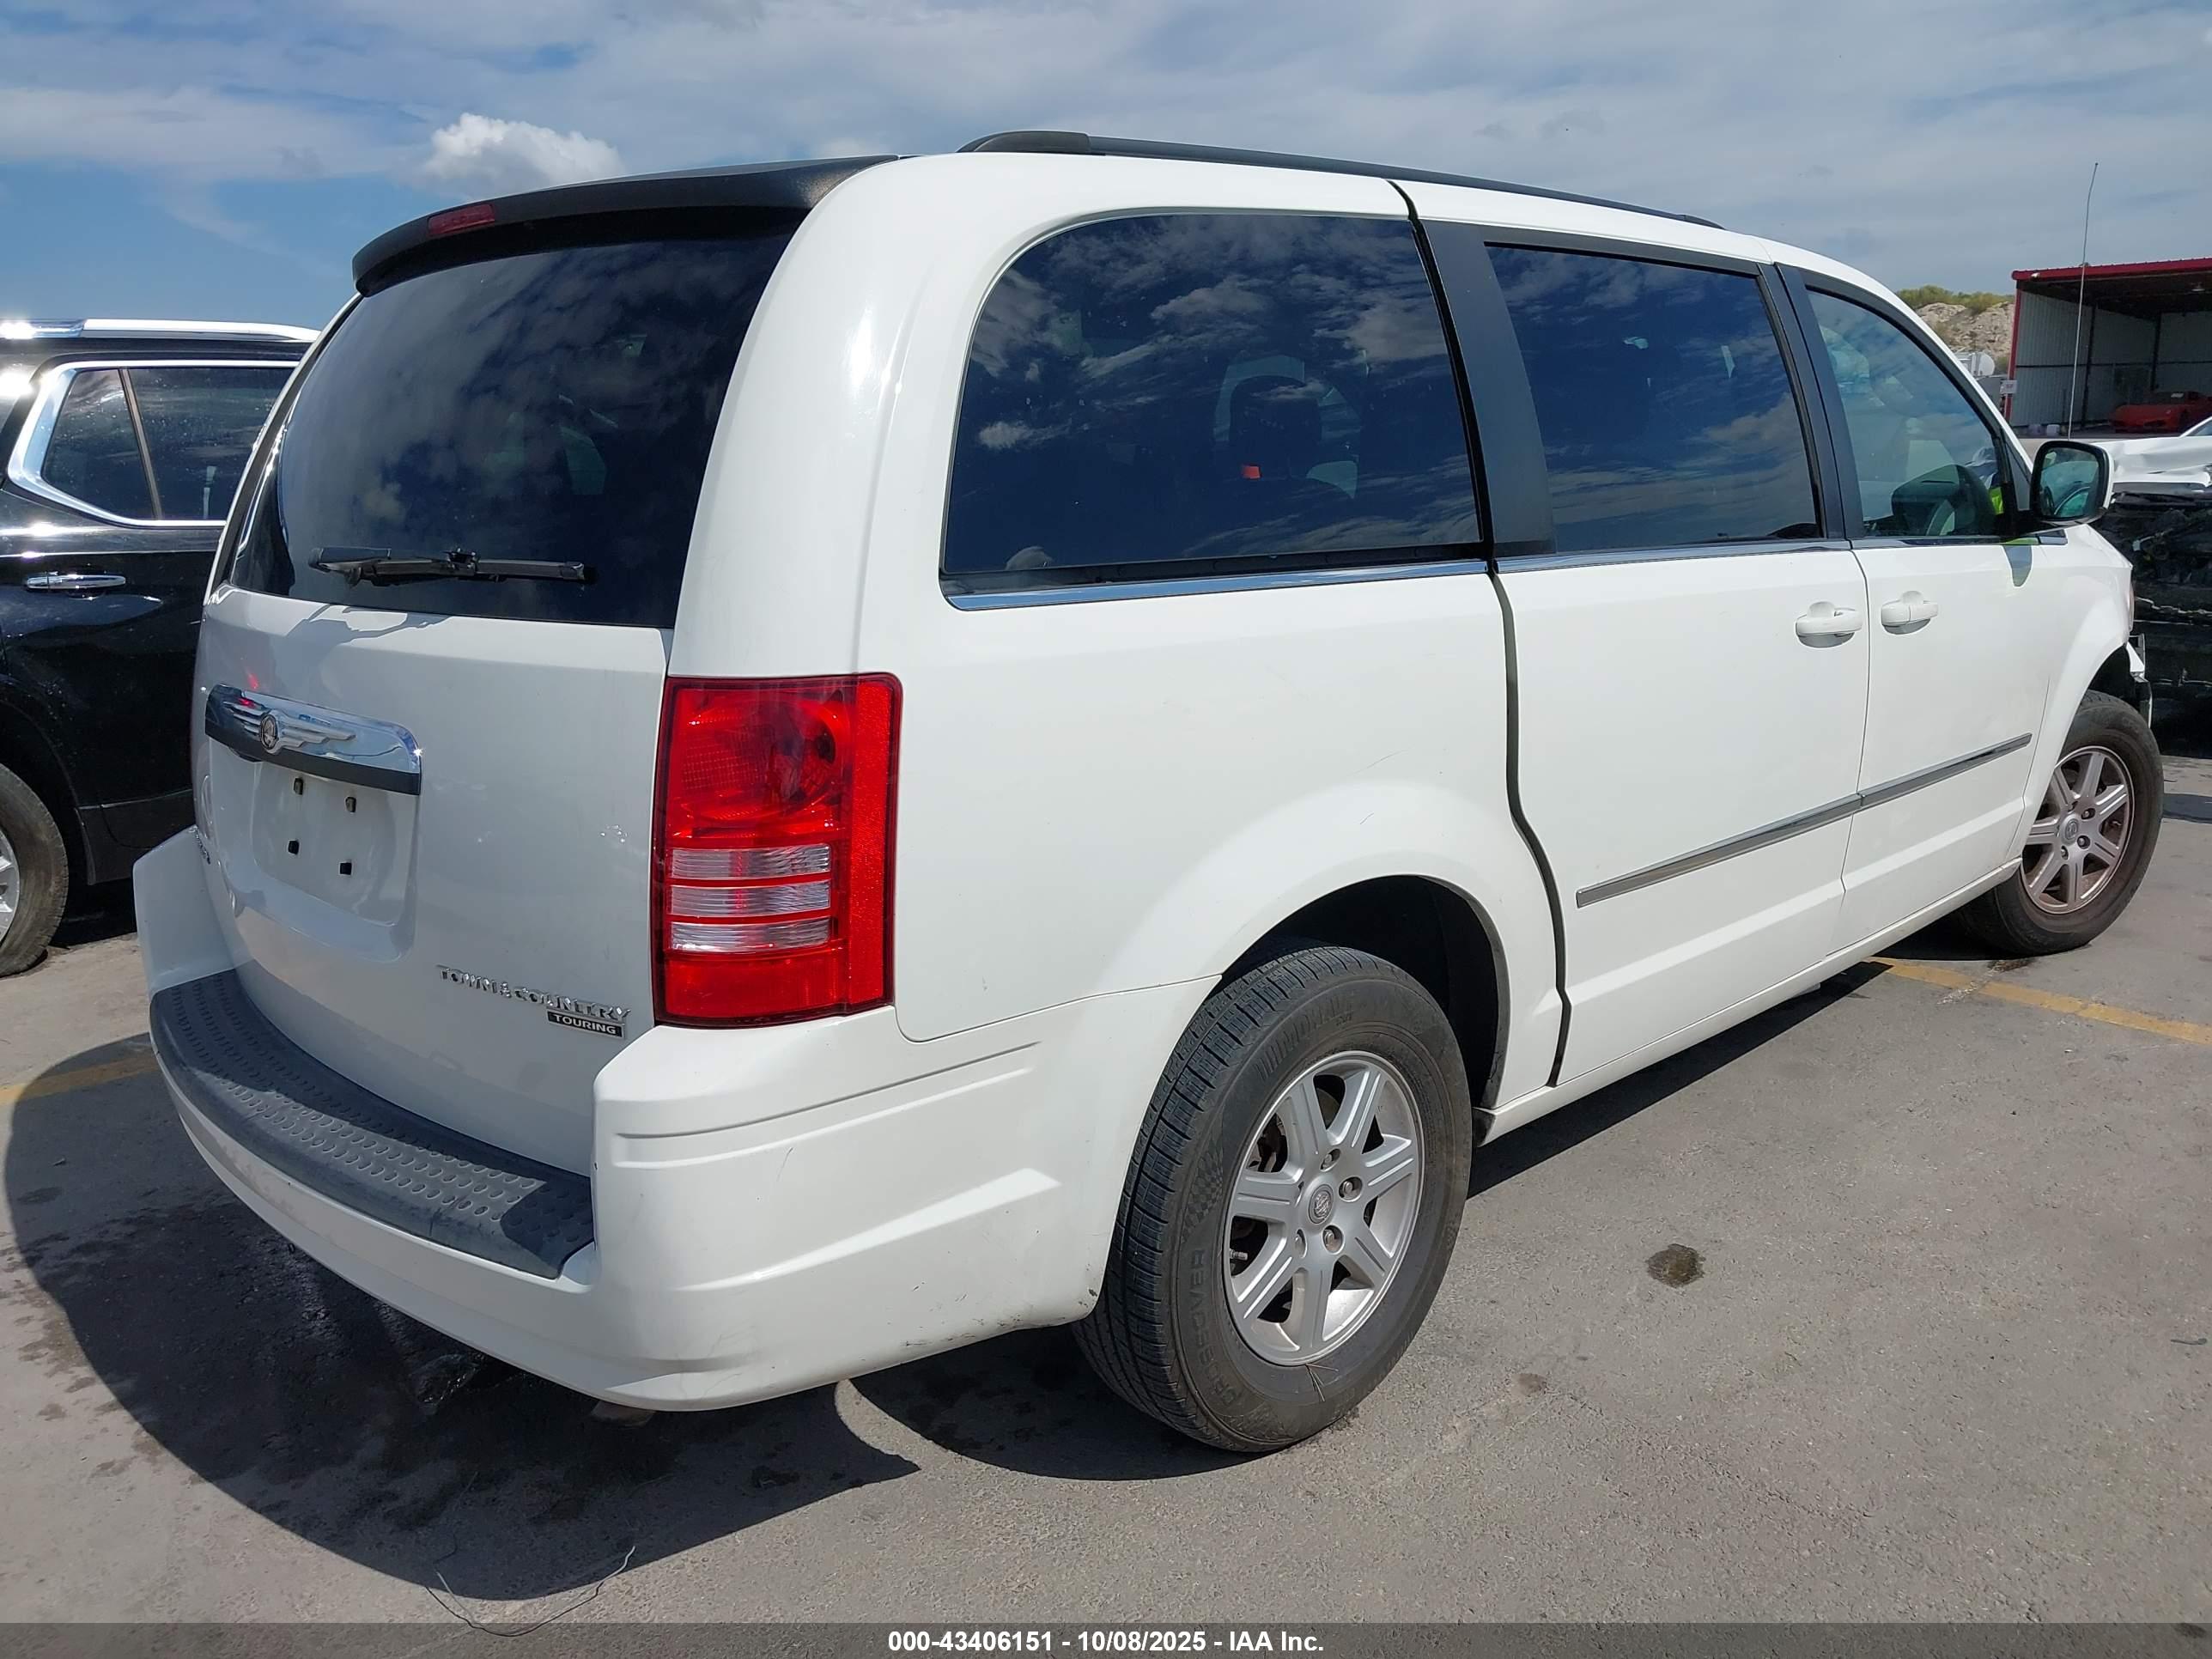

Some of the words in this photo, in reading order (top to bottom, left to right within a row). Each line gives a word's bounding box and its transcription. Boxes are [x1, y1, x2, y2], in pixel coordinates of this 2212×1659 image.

[436, 964, 497, 994] TOWN
[514, 986, 631, 1022] COUNTRY
[553, 1013, 617, 1036] TOURING
